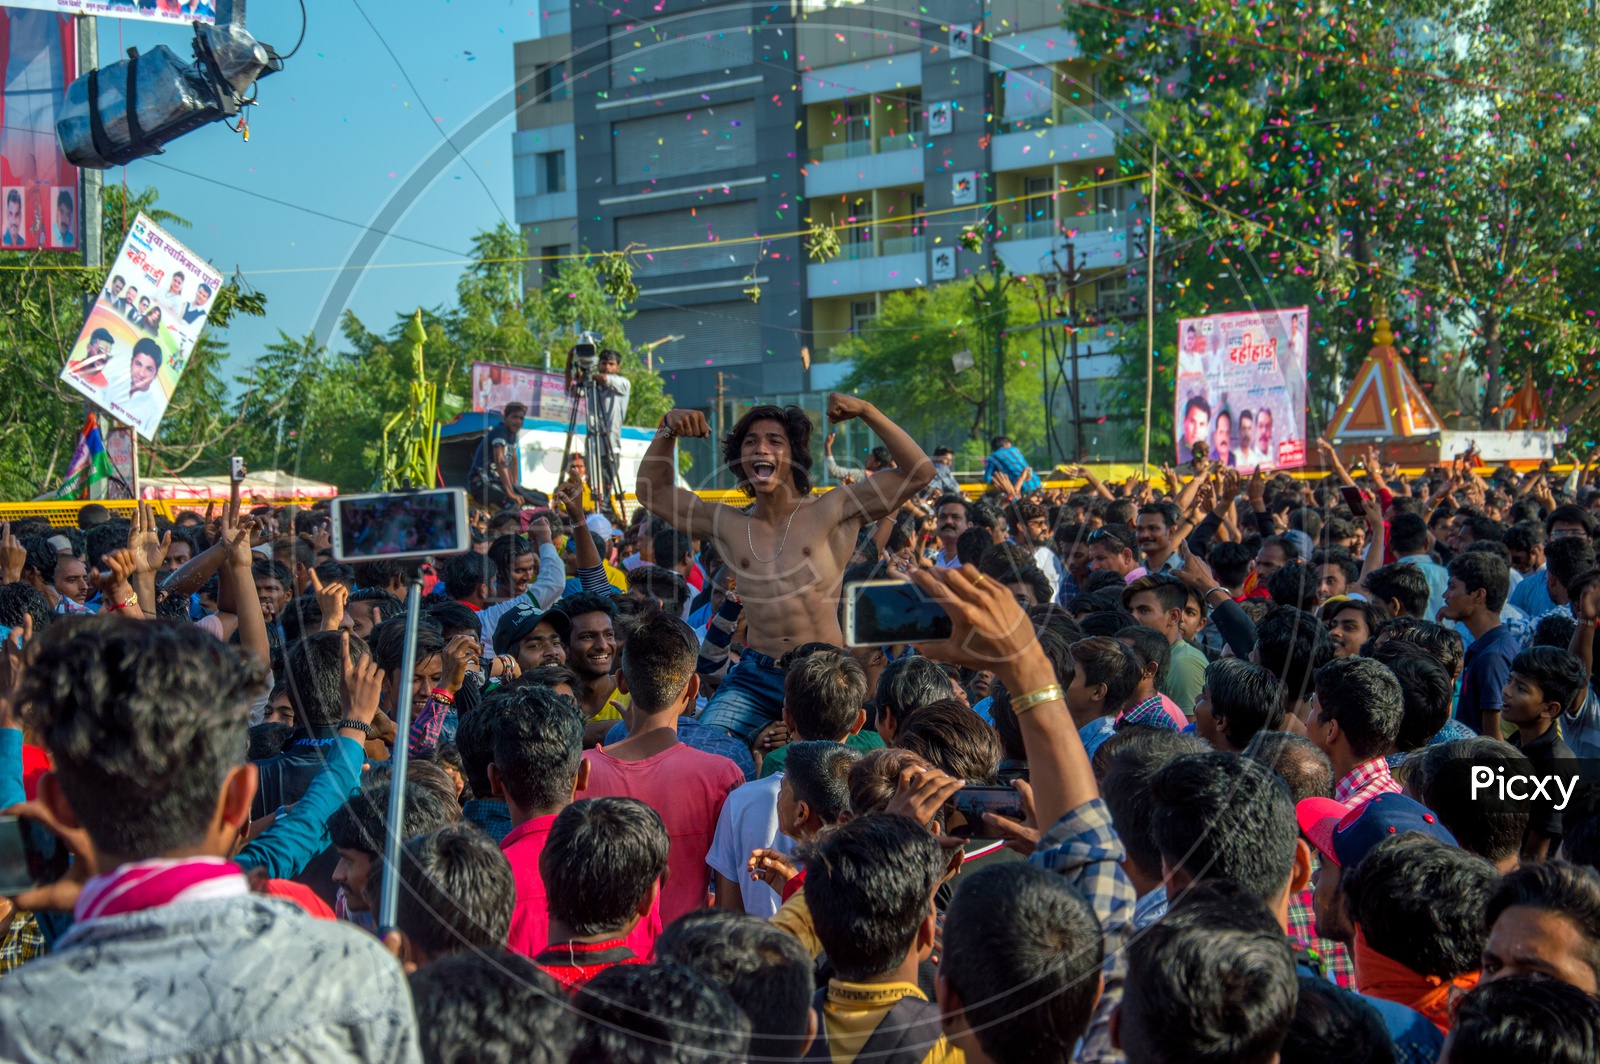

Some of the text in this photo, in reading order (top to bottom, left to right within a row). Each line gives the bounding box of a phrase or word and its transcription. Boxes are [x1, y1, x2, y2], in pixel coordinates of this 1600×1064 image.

[146, 230, 221, 291] युवा स्वाभिमान पार्टी
